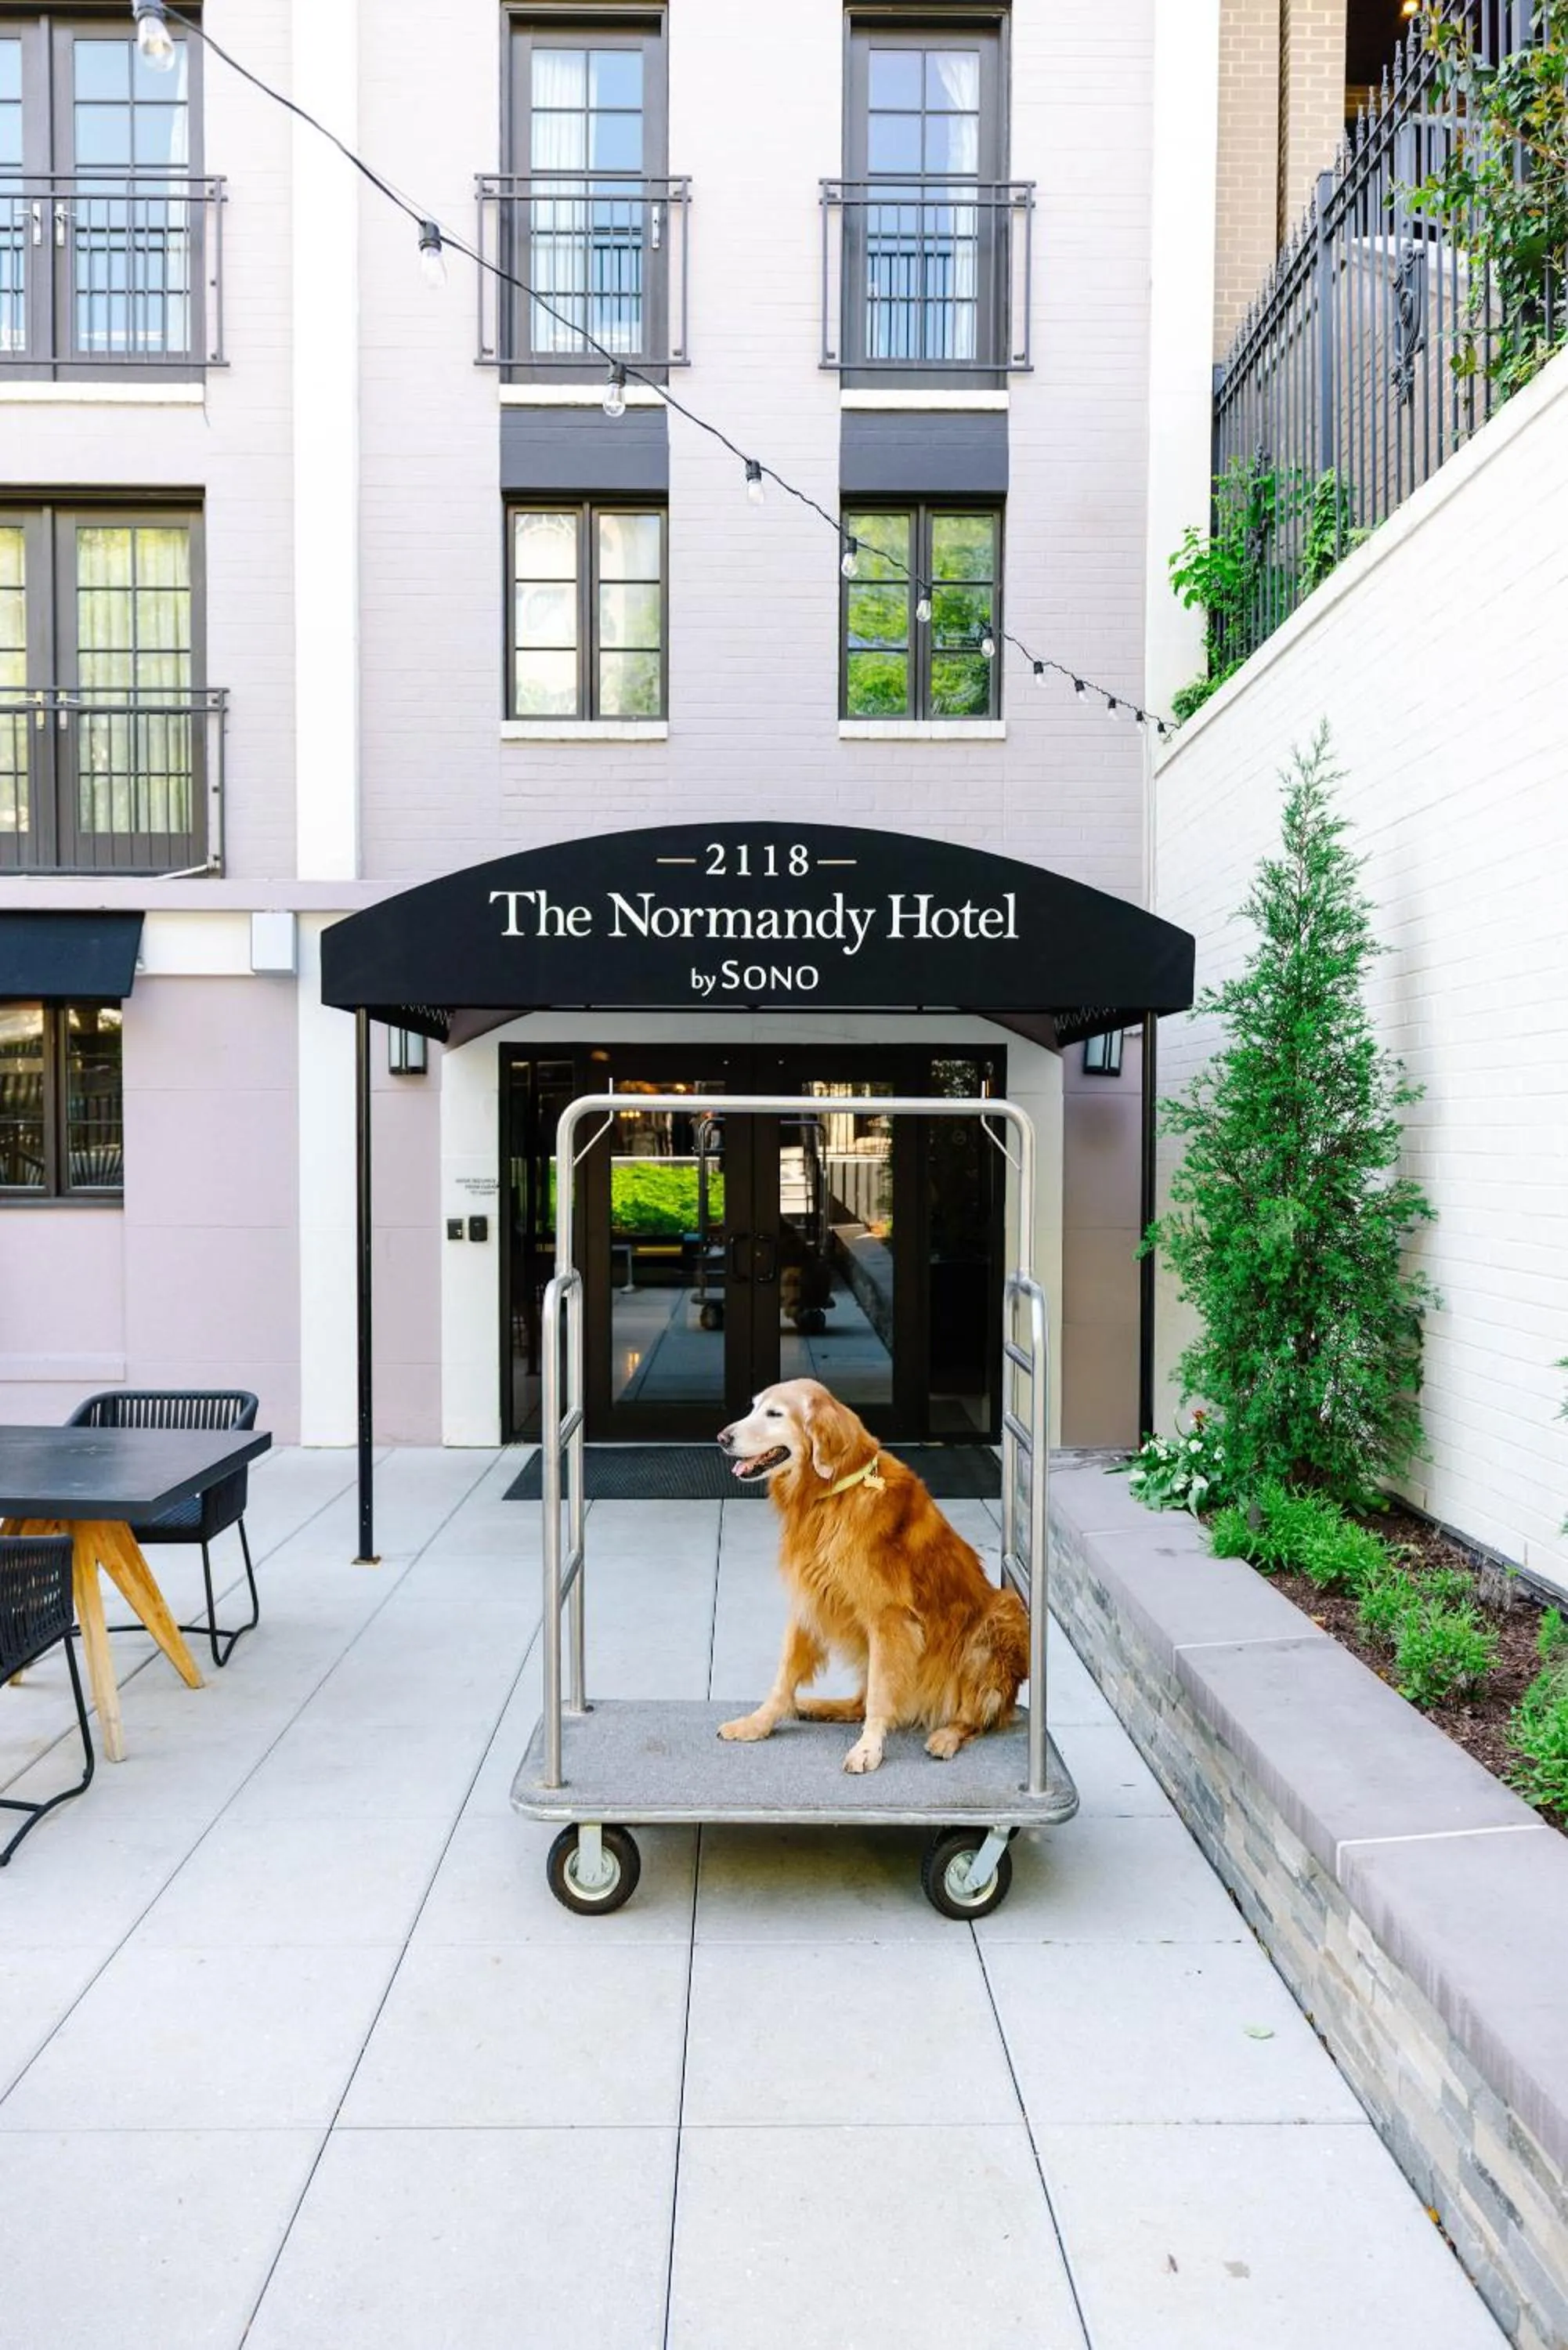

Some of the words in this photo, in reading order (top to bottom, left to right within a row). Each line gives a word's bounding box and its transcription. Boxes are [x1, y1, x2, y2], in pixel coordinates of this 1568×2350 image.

[706, 843, 809, 877] 2118
[489, 889, 592, 937] The
[607, 892, 876, 956] Normandy
[886, 892, 1019, 939] Hotel
[690, 967, 717, 997] by
[721, 960, 819, 990] SONO
